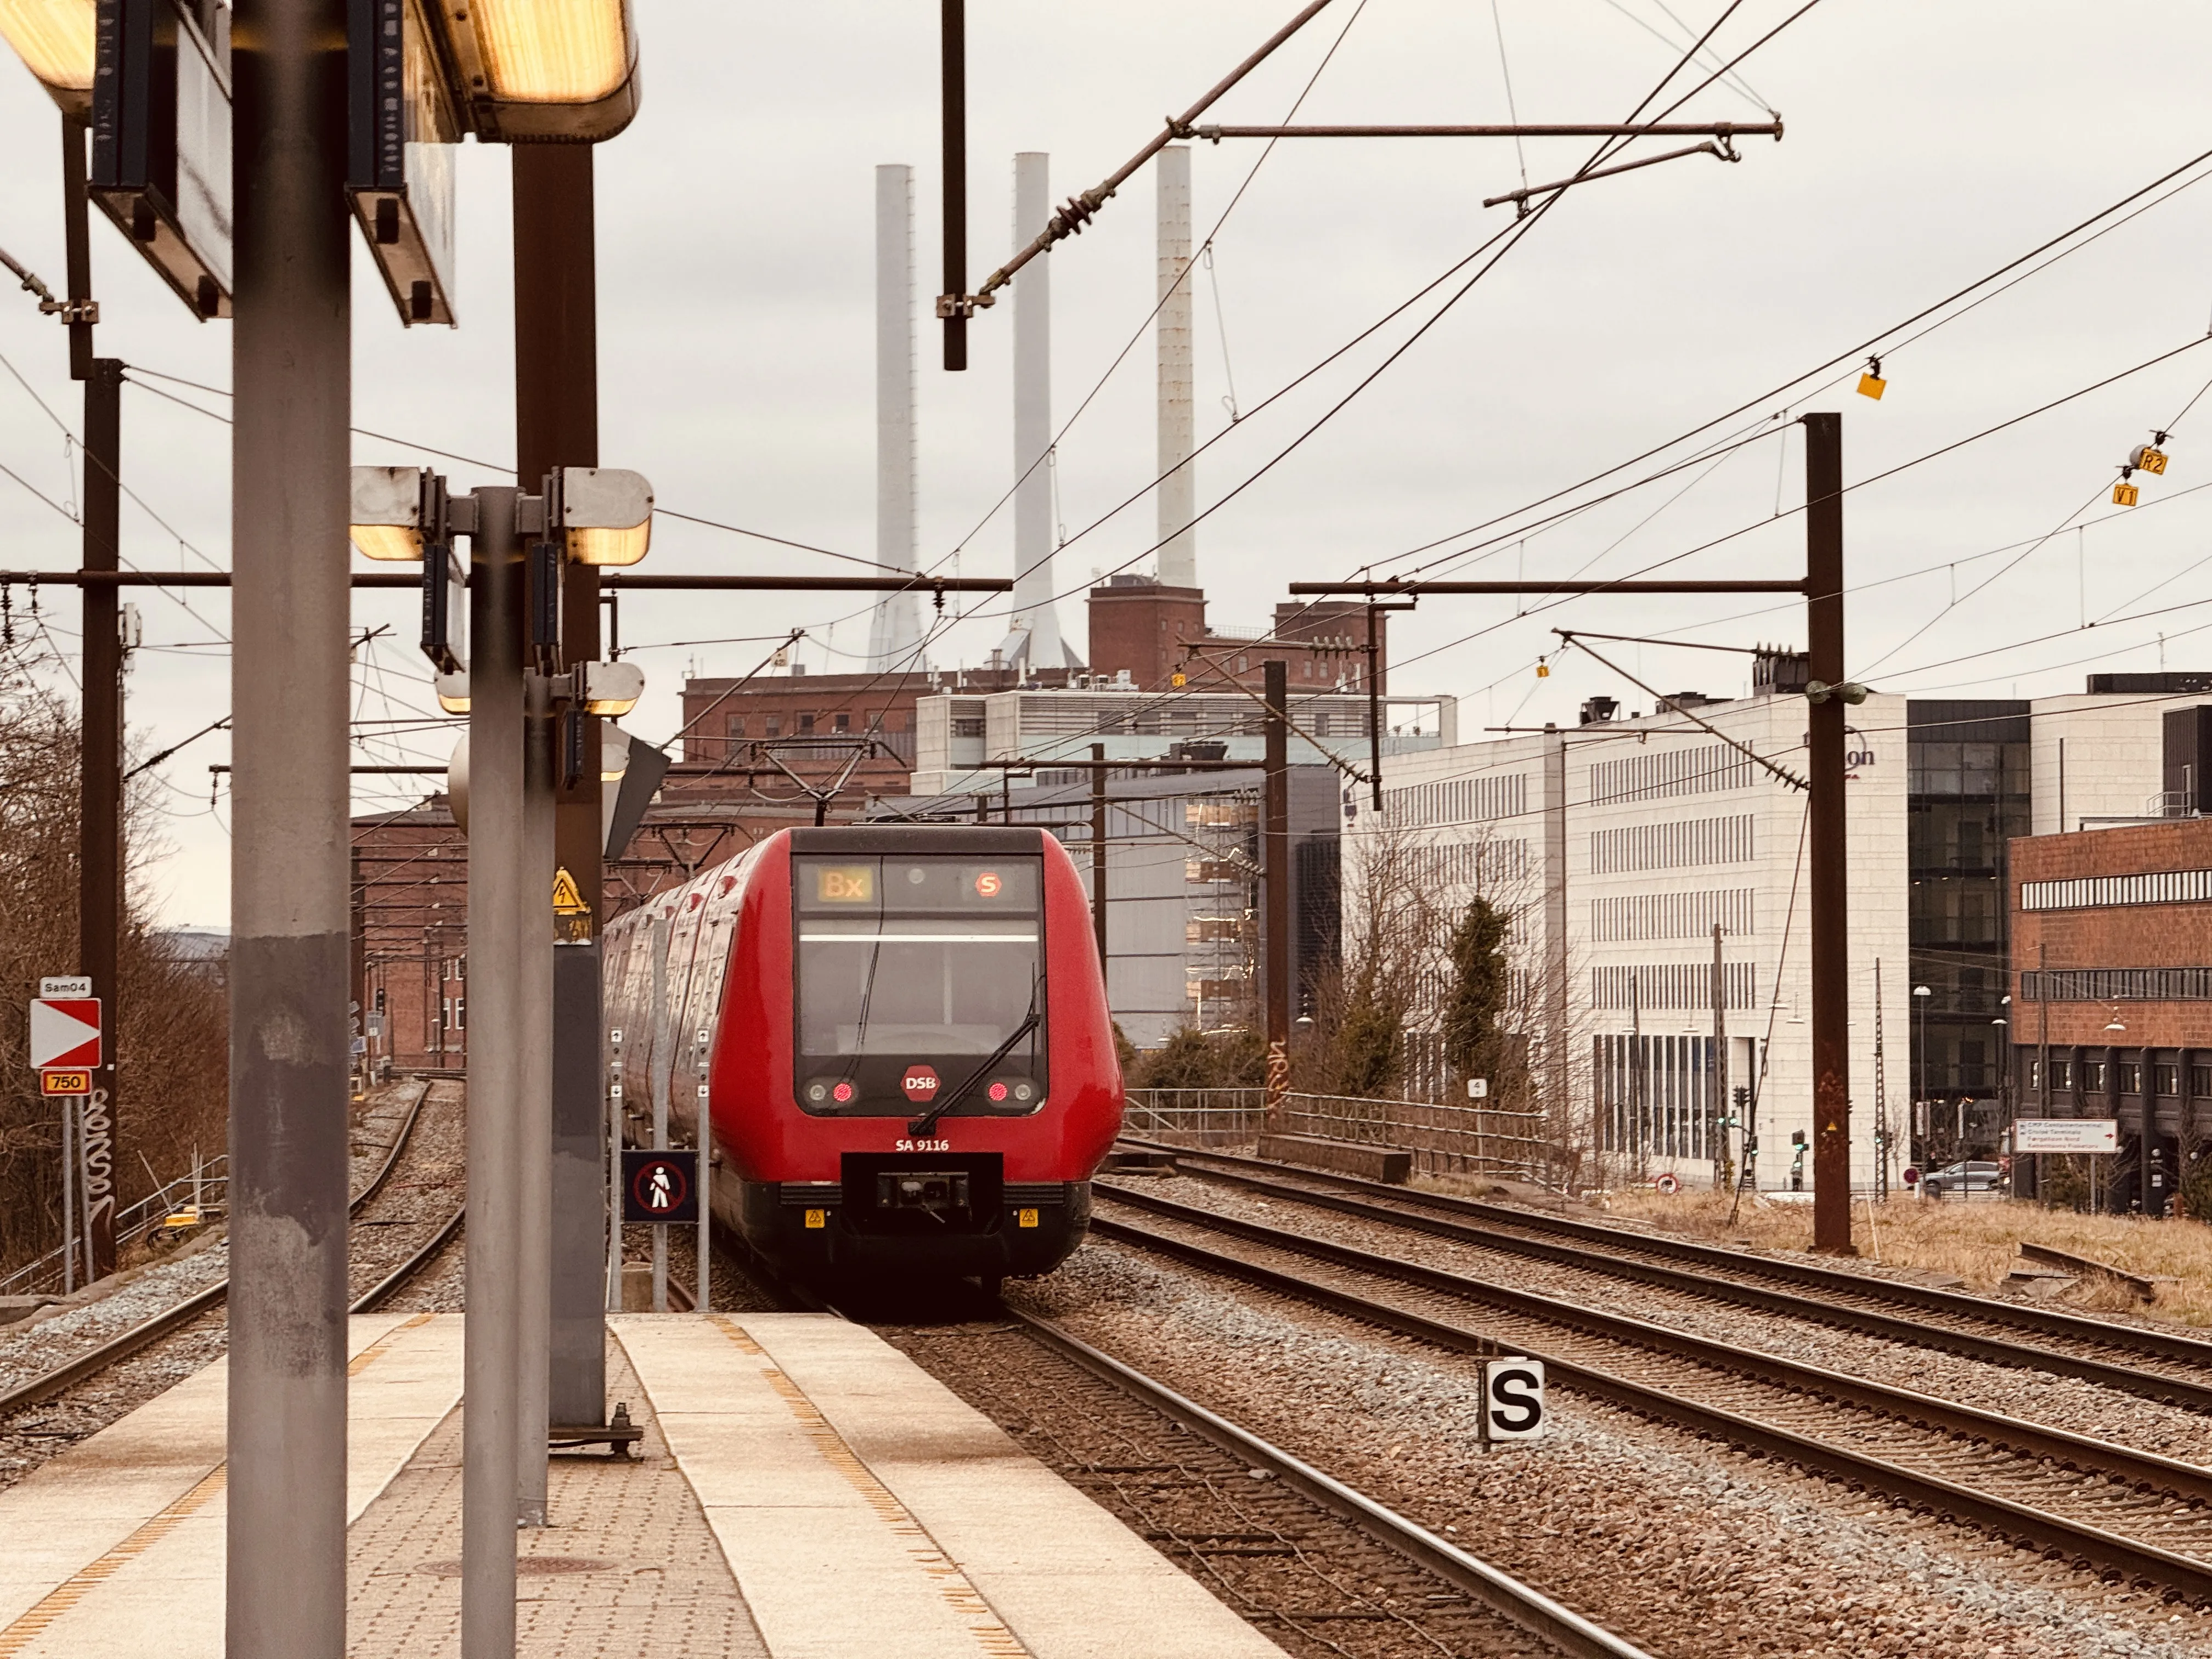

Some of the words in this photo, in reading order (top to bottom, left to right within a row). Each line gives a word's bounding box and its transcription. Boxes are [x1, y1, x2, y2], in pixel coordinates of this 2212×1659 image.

[2143, 455, 2163, 472] R2
[980, 876, 996, 893] S
[44, 983, 86, 992] Sam04
[51, 1076, 81, 1088] 750
[906, 1077, 936, 1090] DSB
[896, 1139, 914, 1152] SA
[917, 1139, 950, 1152] 9116
[1491, 1369, 1541, 1432] S
